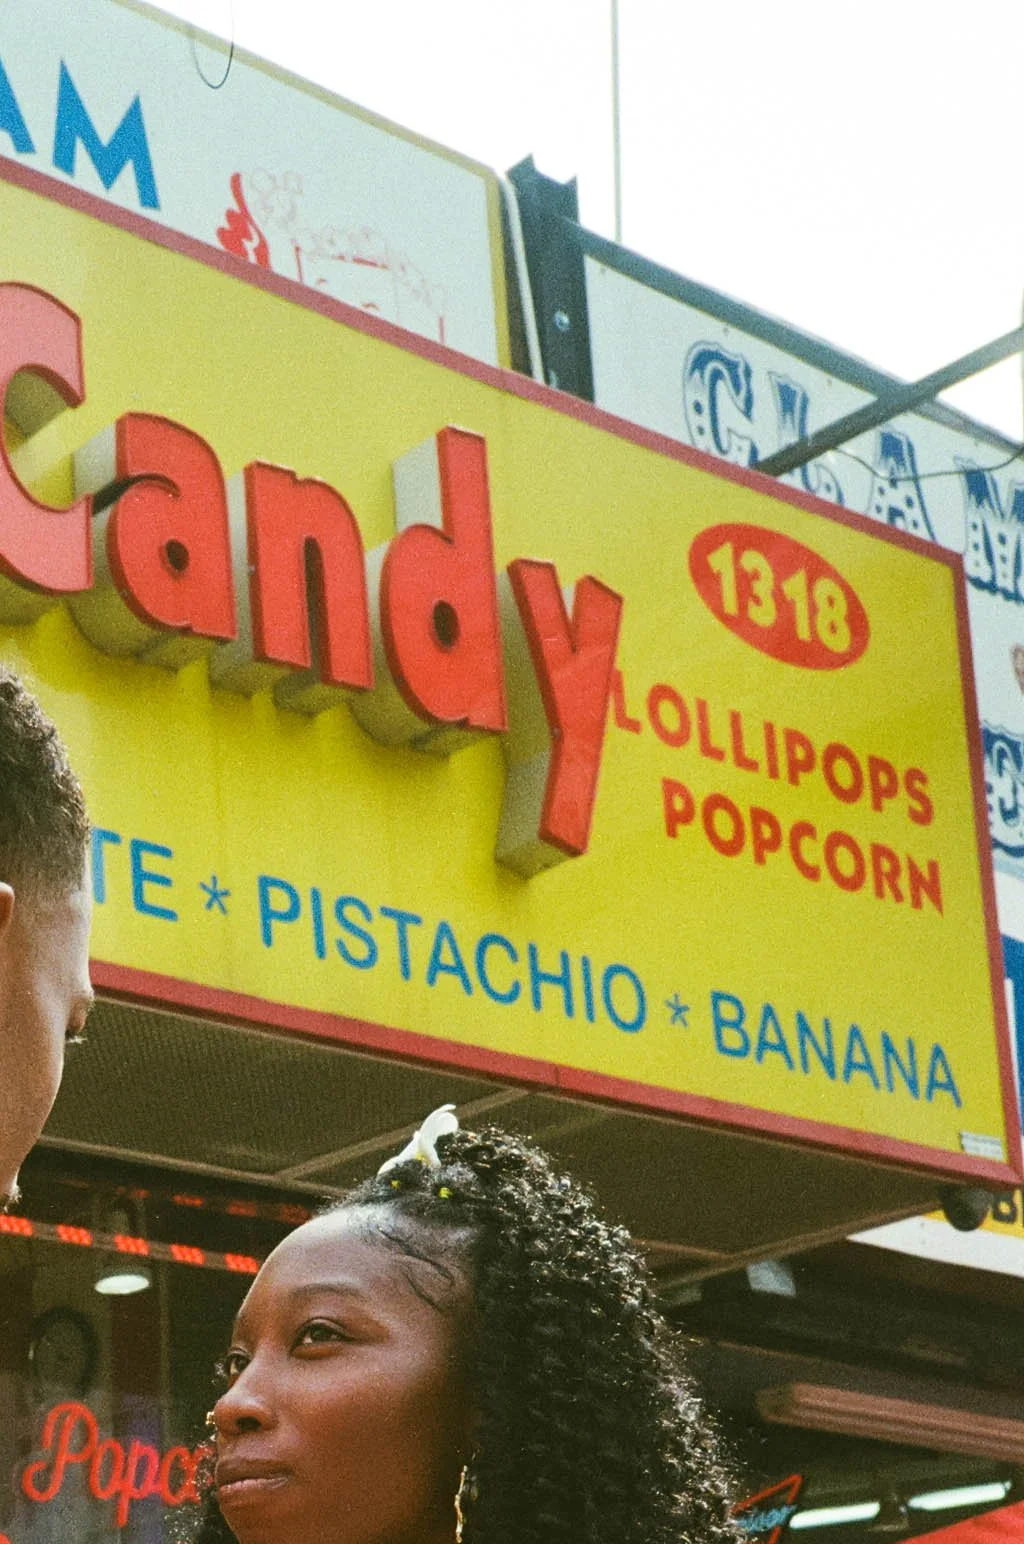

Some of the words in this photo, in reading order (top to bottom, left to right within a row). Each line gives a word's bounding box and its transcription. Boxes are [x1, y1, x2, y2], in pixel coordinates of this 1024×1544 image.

[708, 542, 852, 655] 1318
[612, 667, 935, 827] LOLLIPOPS
[662, 776, 944, 918] POPCORN
[256, 875, 649, 1034] PISTACHIO
[709, 989, 964, 1109] BANANA
